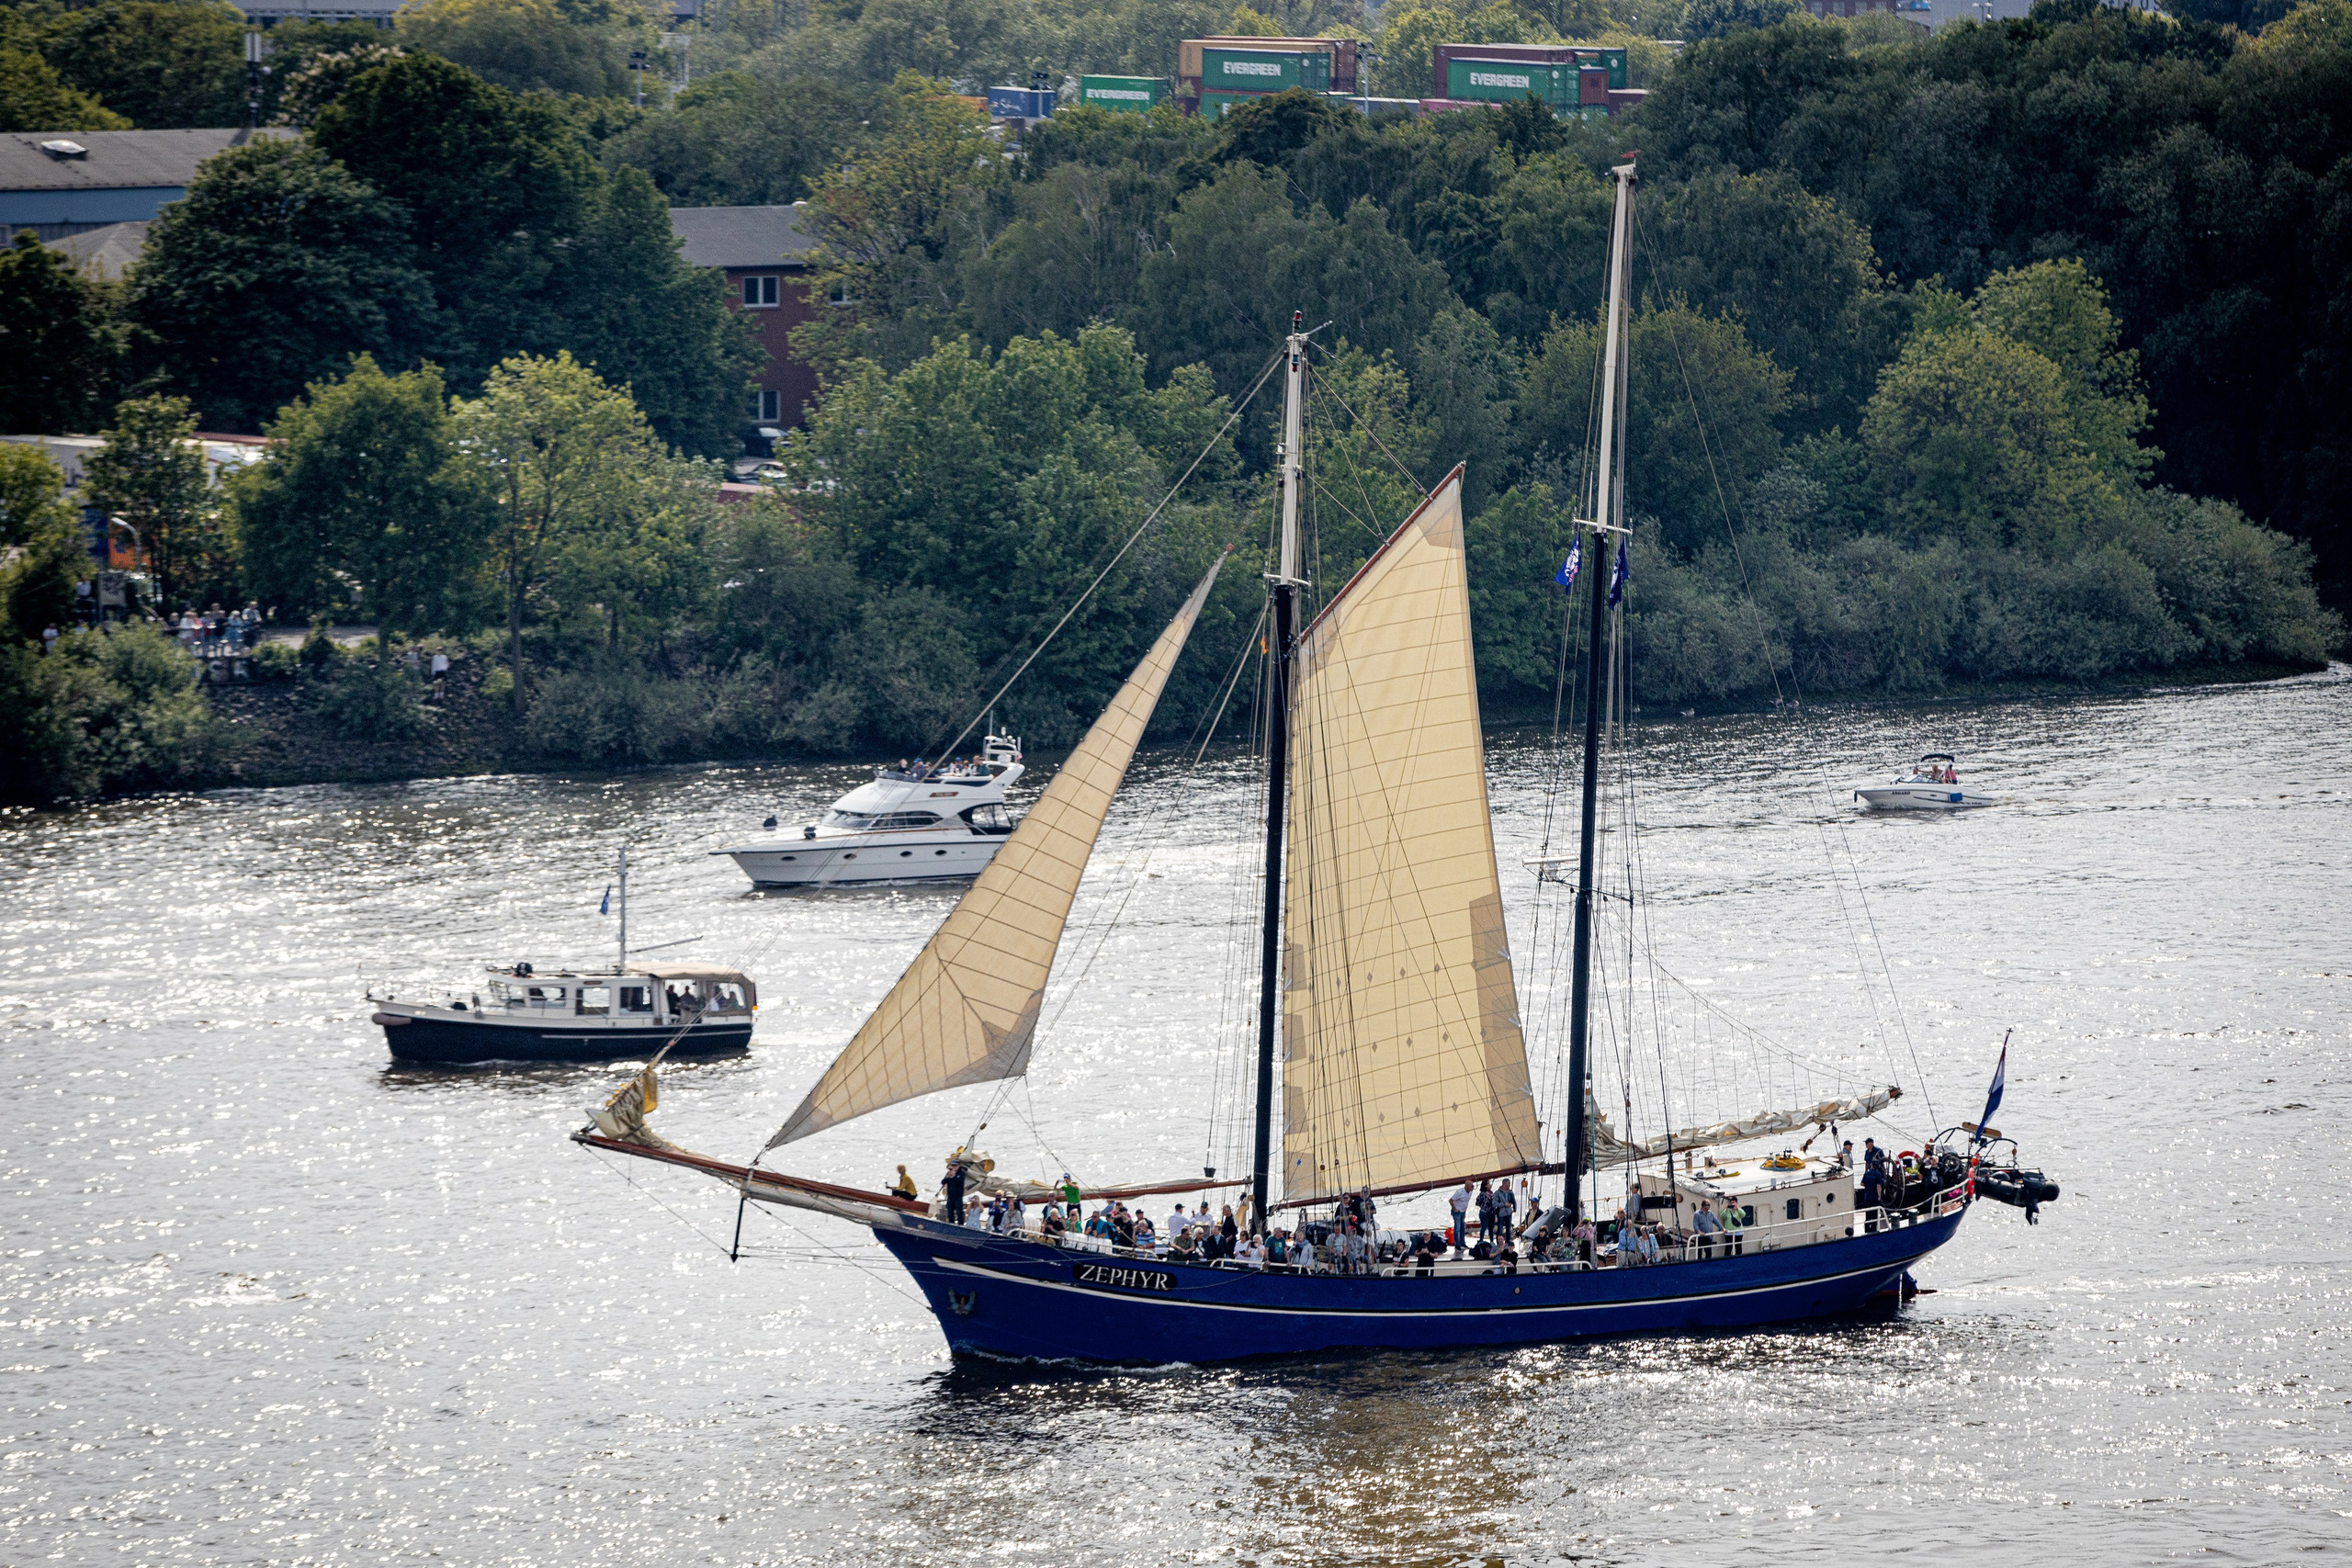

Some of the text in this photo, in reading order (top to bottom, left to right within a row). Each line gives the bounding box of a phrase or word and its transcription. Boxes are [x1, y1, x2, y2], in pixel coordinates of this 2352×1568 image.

[1223, 62, 1281, 76] EVERGREEN
[1470, 72, 1530, 88] EVERGREEN
[1086, 88, 1149, 101] EVERGREEN
[1080, 1264, 1169, 1291] ZEPHYR
